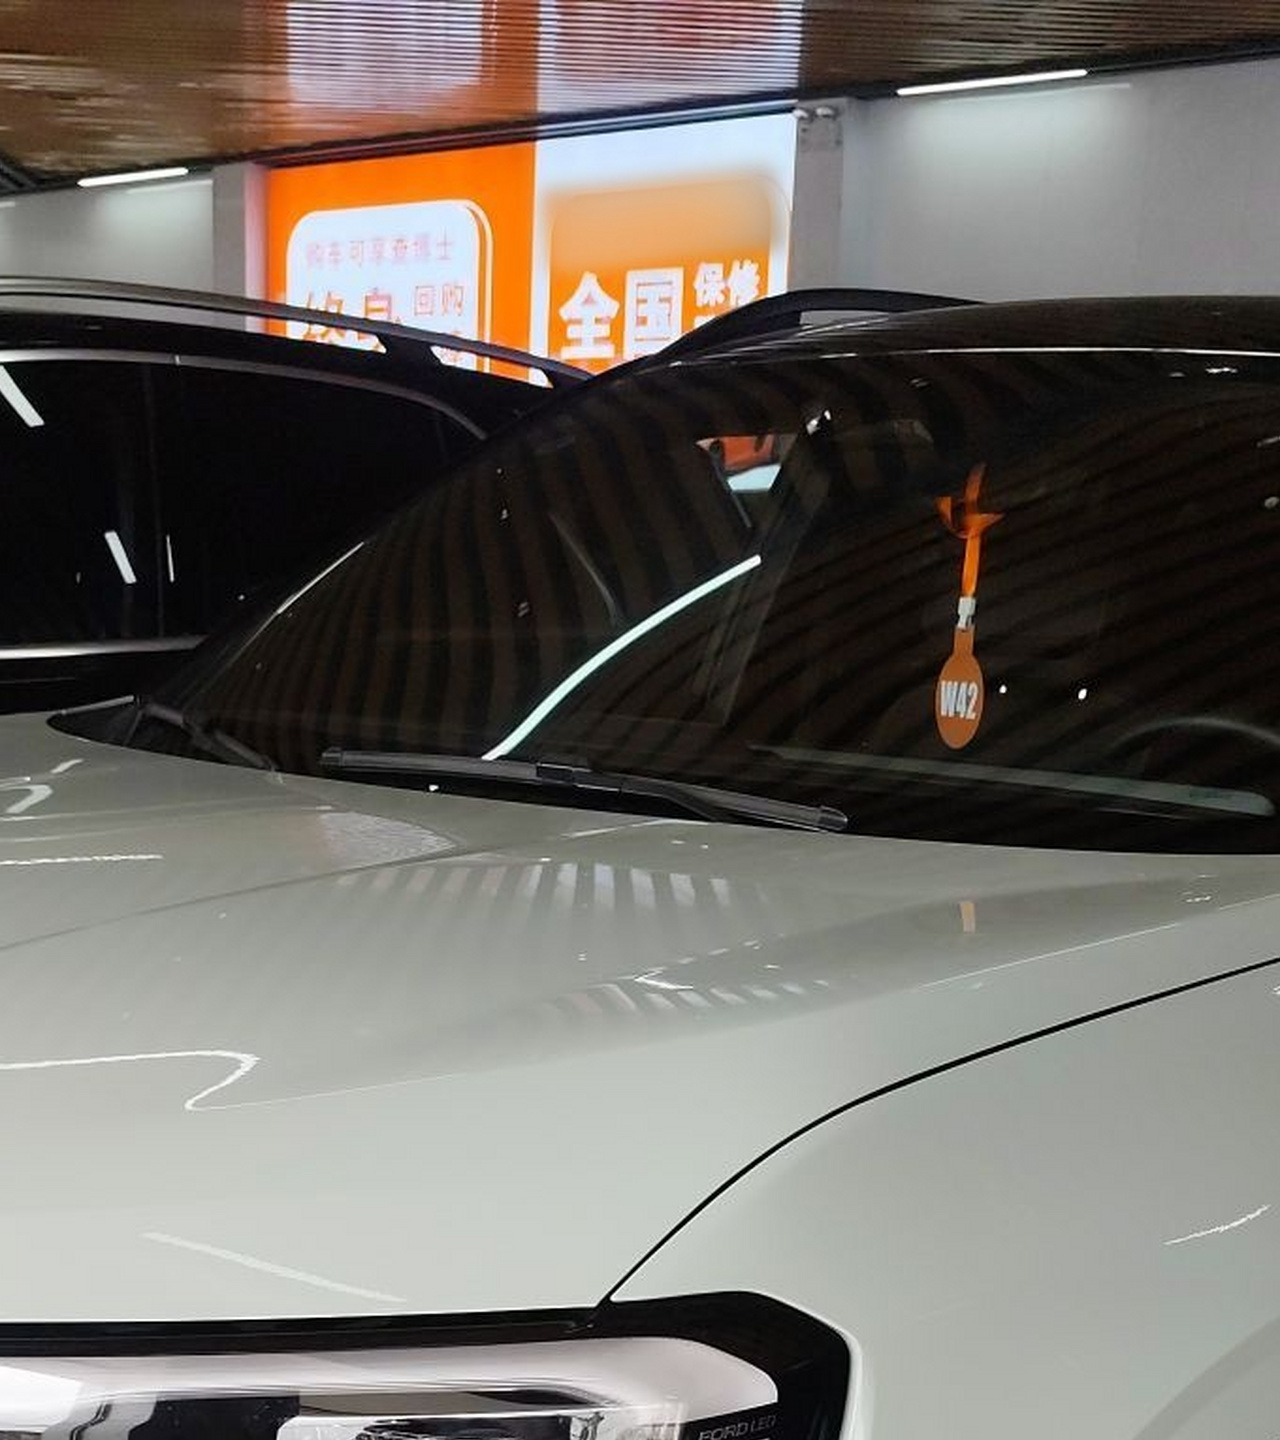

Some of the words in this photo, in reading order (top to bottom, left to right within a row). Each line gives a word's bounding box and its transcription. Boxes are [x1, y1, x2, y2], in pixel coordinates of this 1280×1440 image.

[413, 282, 465, 316] 回购
[693, 259, 760, 307] 保修
[558, 267, 685, 360] 全国
[940, 681, 978, 720] W42
